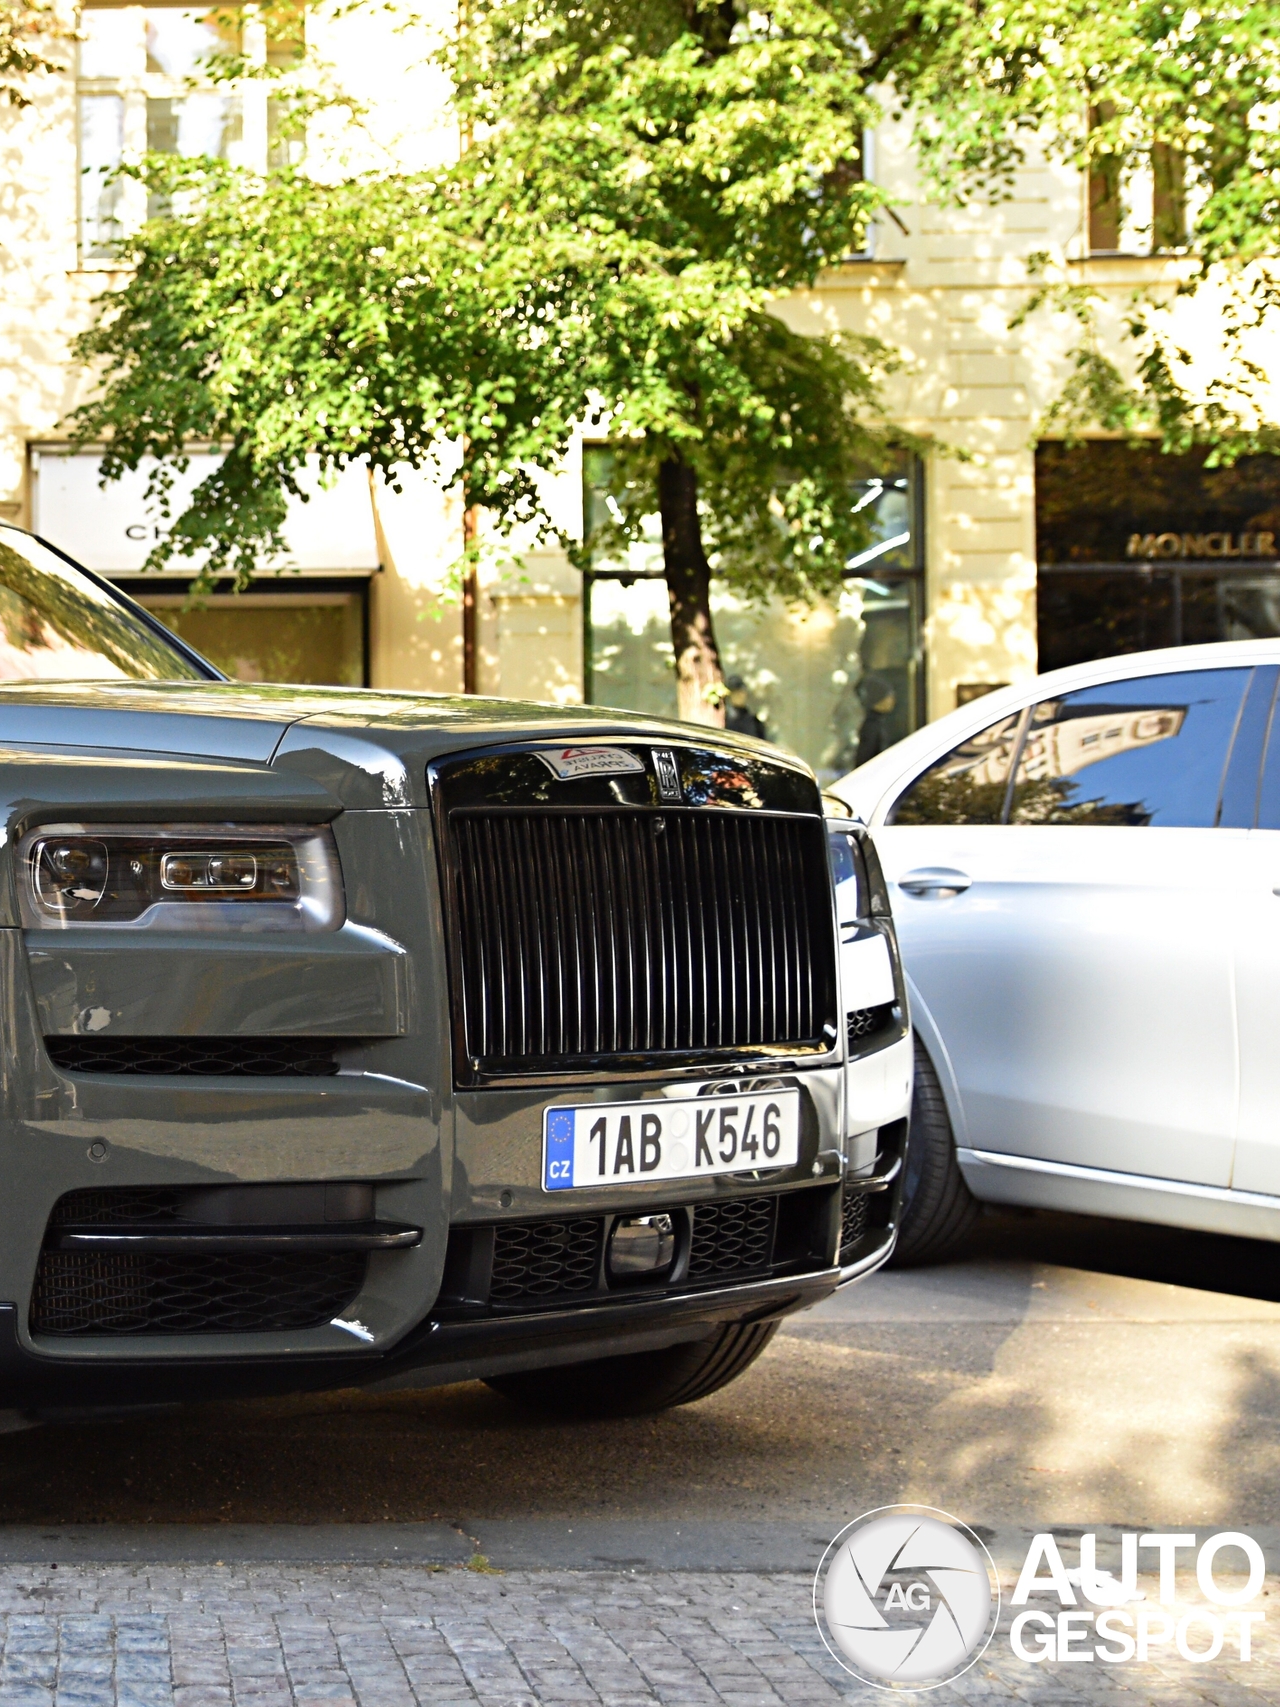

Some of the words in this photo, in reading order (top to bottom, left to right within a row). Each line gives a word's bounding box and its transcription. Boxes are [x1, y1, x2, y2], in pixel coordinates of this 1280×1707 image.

[1126, 532, 1277, 557] MONCLER
[589, 1113, 662, 1176] 1AB
[695, 1103, 781, 1167] K546
[549, 1160, 570, 1179] CZ
